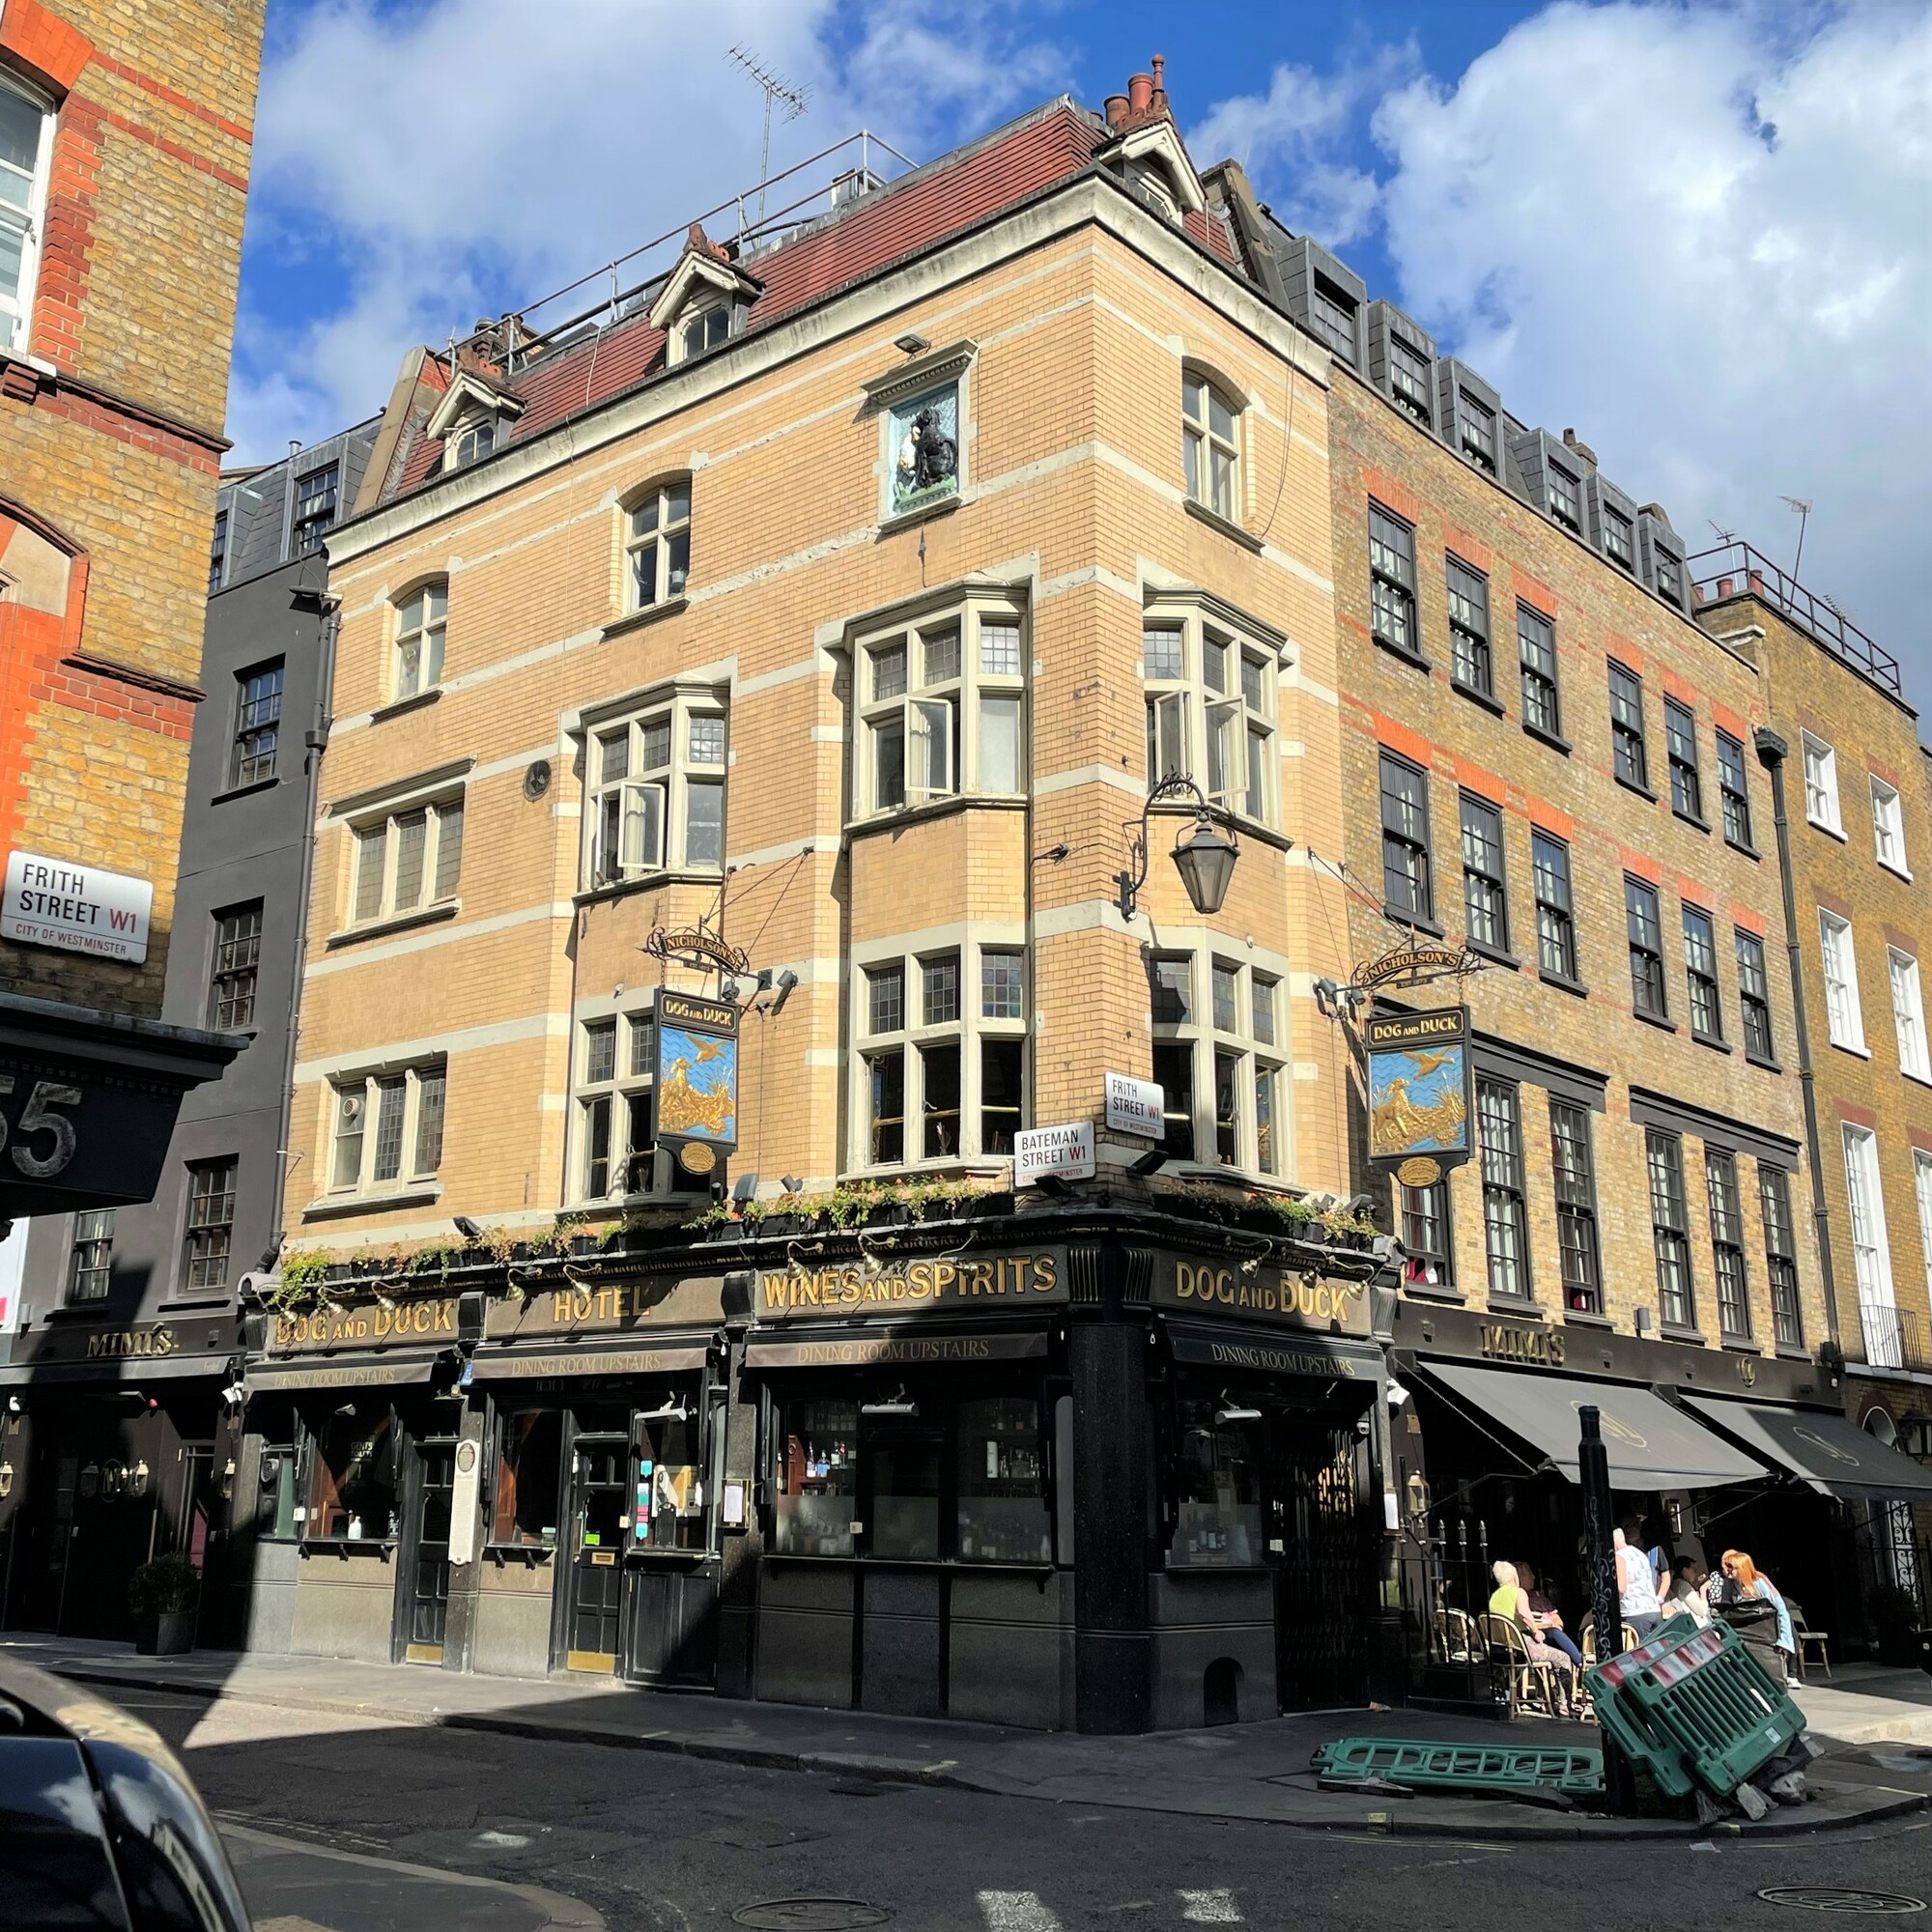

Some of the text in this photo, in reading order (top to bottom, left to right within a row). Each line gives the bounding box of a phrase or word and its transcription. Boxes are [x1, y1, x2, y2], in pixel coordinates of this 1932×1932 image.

[22, 863, 85, 895] FRITH
[19, 890, 137, 933] STREET W1
[15, 923, 127, 955] CITY OF WESTMINSTER
[667, 936, 737, 964] NICHOLSON'S
[1367, 952, 1458, 979] NICHOLSON'S
[666, 1000, 690, 1017] DOG
[703, 1008, 731, 1026] DUCK
[1374, 1016, 1458, 1040] DOG AND DUCK
[1112, 1079, 1138, 1098] FRITH
[1113, 1096, 1160, 1122] STREET W1
[0, 1073, 84, 1179] 5
[1022, 1129, 1079, 1151] BATEMAN
[1022, 1146, 1086, 1168] STREET W1
[763, 1254, 1057, 1309] WINES AND SPIRITS
[1176, 1261, 1350, 1321] DOG AND DUCK
[553, 1286, 652, 1322] HOTEL
[275, 1299, 456, 1345] DOG AND DUCK
[511, 1354, 662, 1376] DINING ROOM UPSTAIRS
[797, 1340, 990, 1363] DINING ROOM UPSTAIRS
[1211, 1344, 1355, 1377] DINING ROOM UPSTAIRS
[274, 1368, 395, 1387] DINING ROOM UPSTAIRS
